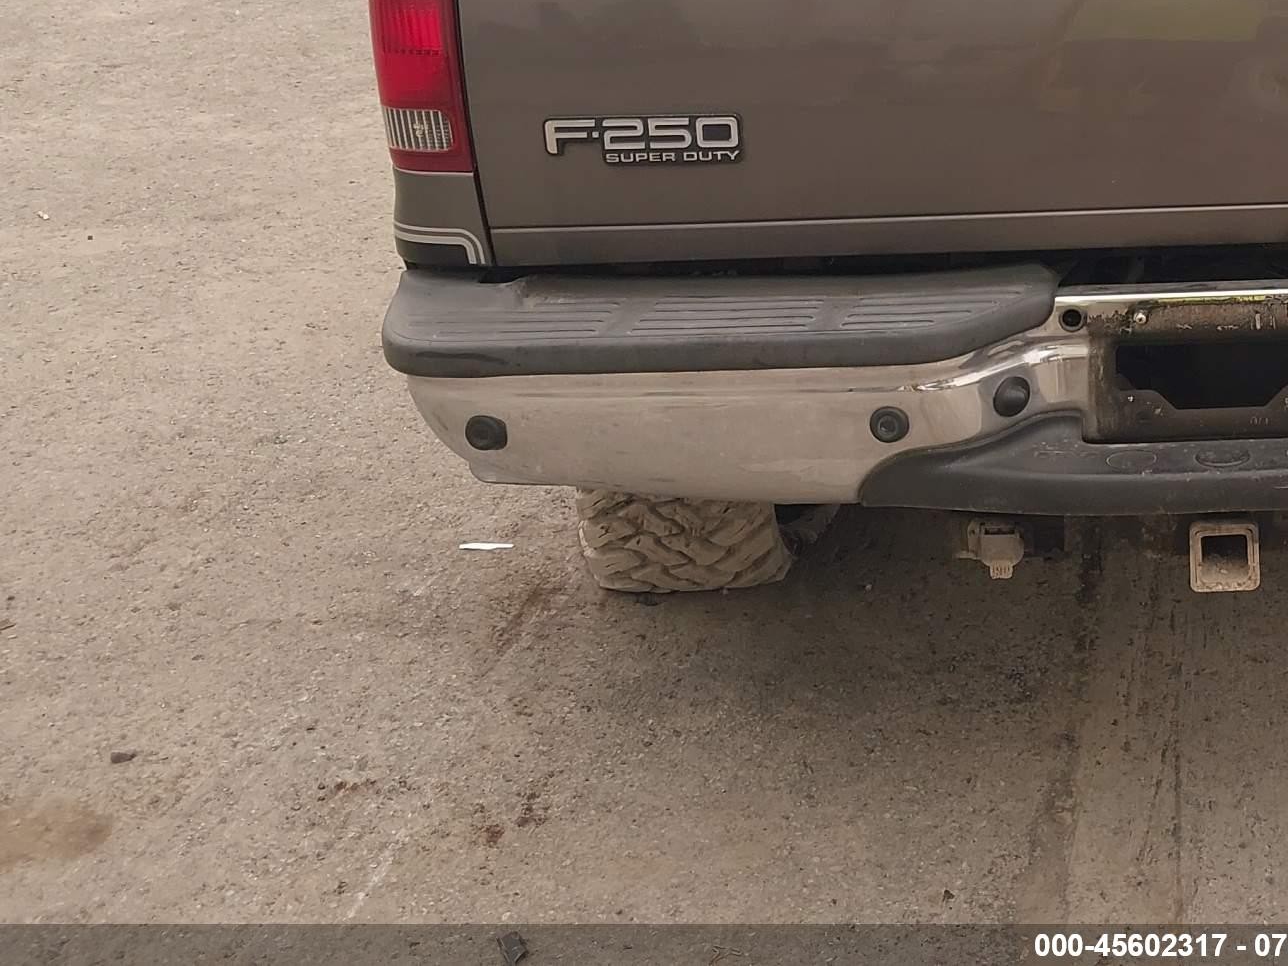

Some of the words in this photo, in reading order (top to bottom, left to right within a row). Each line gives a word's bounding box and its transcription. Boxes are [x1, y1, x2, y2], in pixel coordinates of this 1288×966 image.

[544, 117, 740, 154] F-250
[605, 152, 676, 163] SUPER
[683, 150, 740, 162] DUTY
